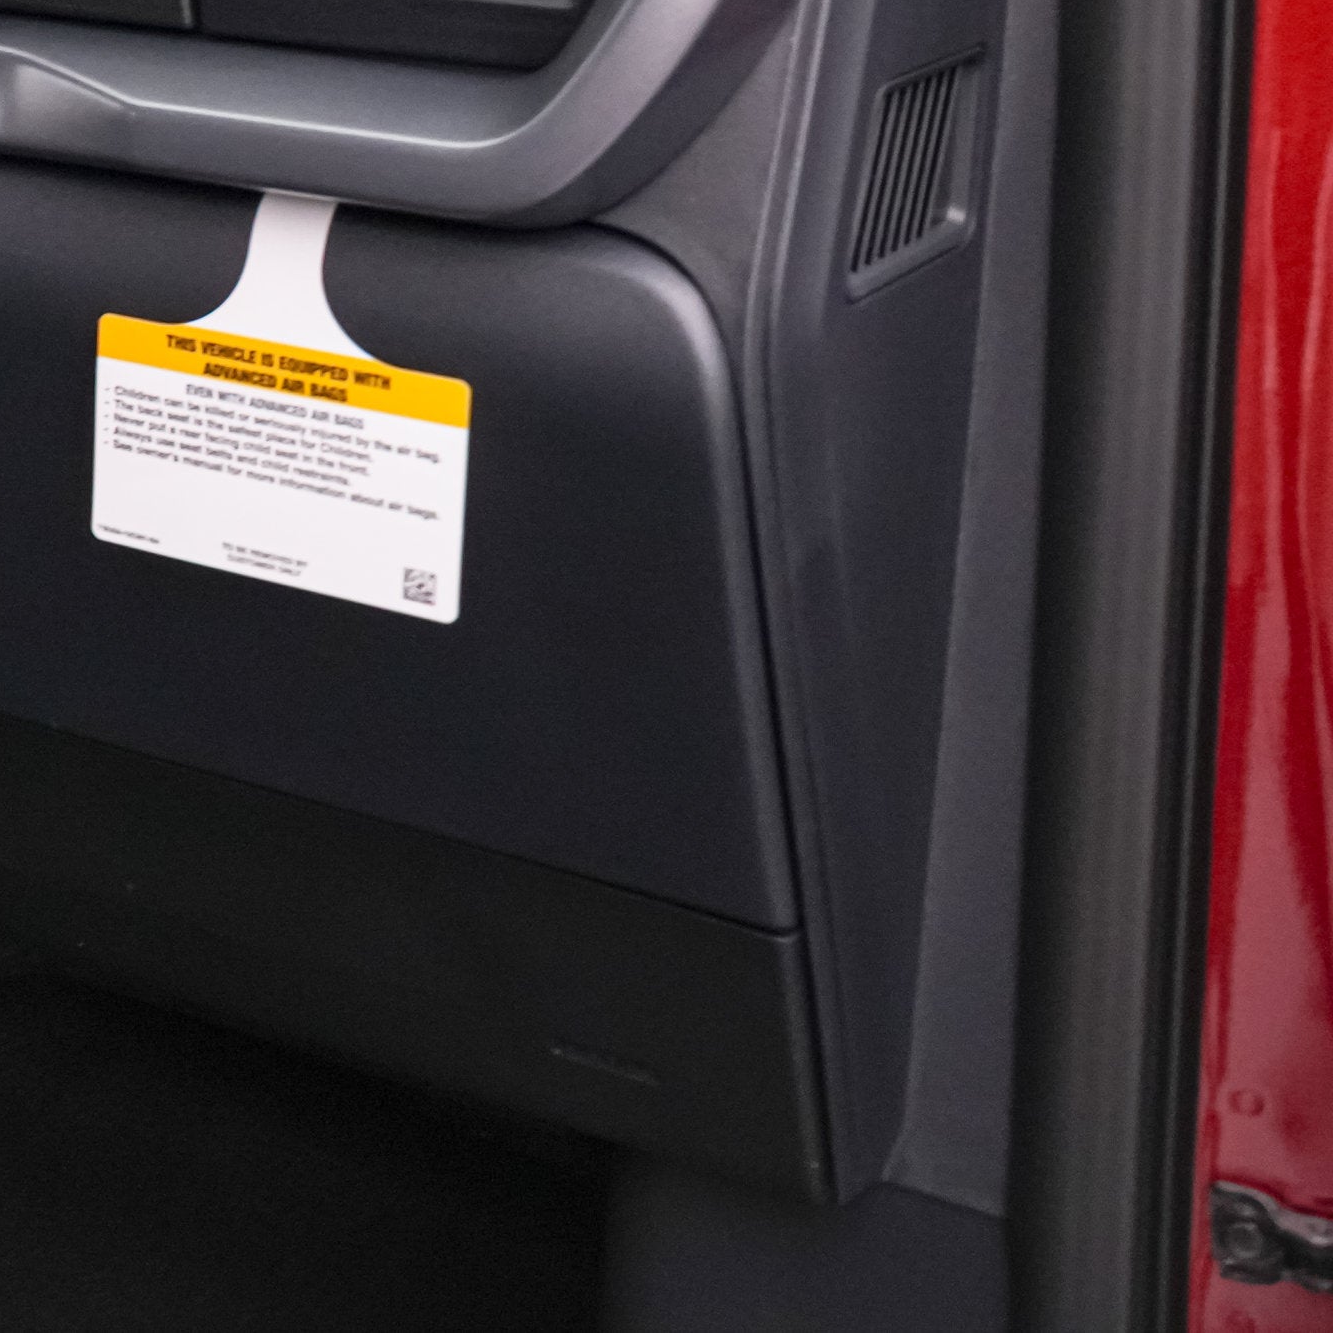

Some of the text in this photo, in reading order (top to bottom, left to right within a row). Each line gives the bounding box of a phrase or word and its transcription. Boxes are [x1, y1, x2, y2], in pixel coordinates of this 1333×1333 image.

[166, 334, 391, 390] THIS VEHICLE IS EQUIPPED WITH
[203, 363, 348, 402] ADVANCED AIR BAGS
